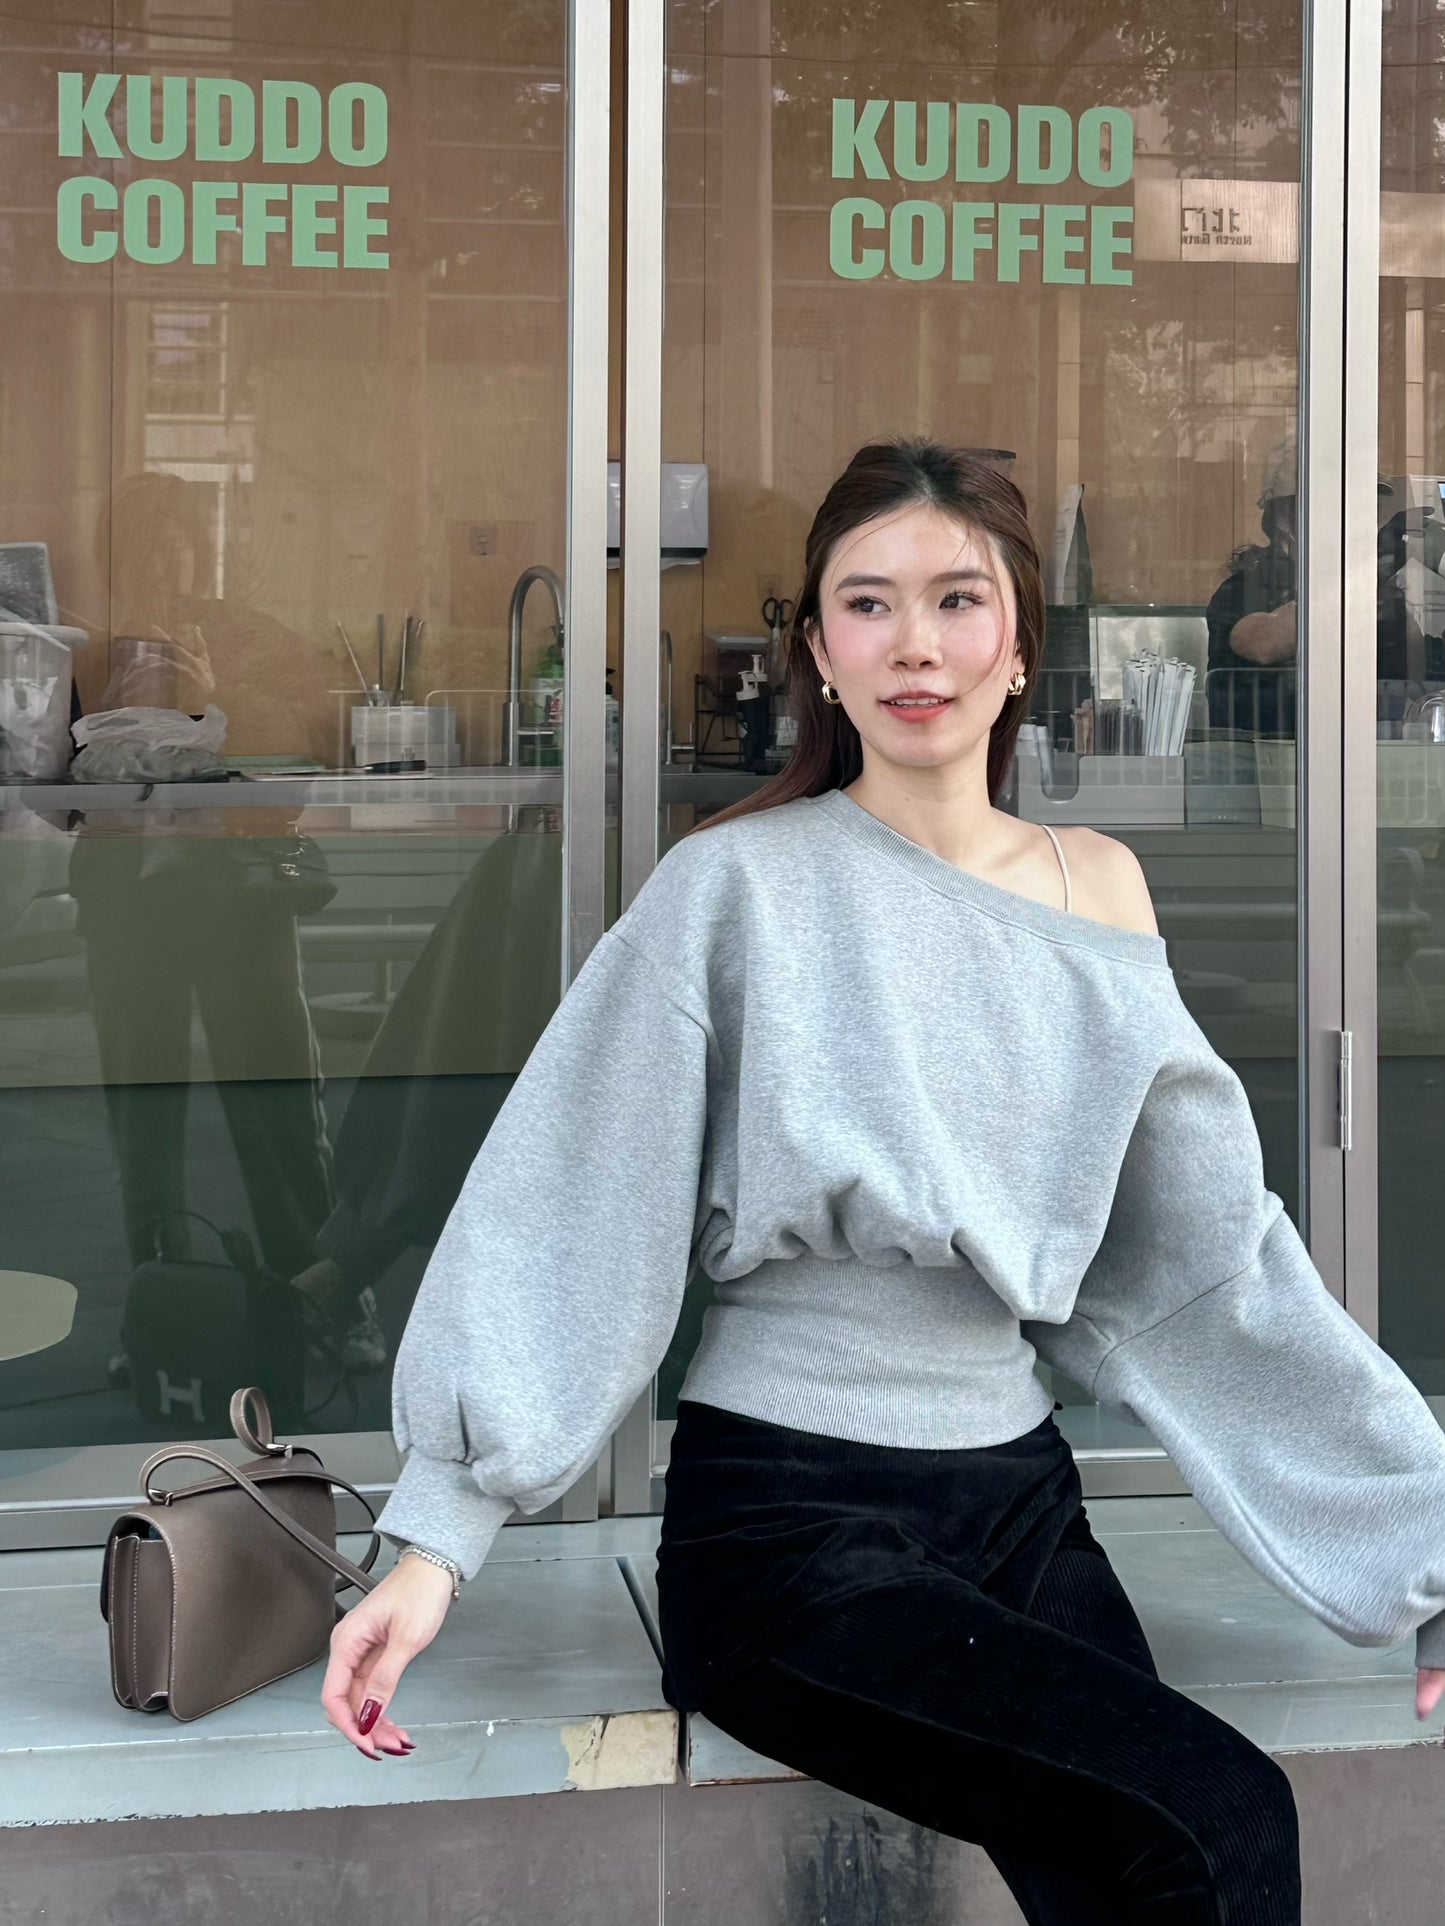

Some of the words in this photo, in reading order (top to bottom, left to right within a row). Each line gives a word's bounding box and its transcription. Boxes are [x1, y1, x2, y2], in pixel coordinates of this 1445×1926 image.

[56, 71, 389, 168] KUDDO
[830, 98, 1134, 187] KUDDO
[56, 175, 390, 271] COFFEE
[829, 197, 1133, 286] COFFEE
